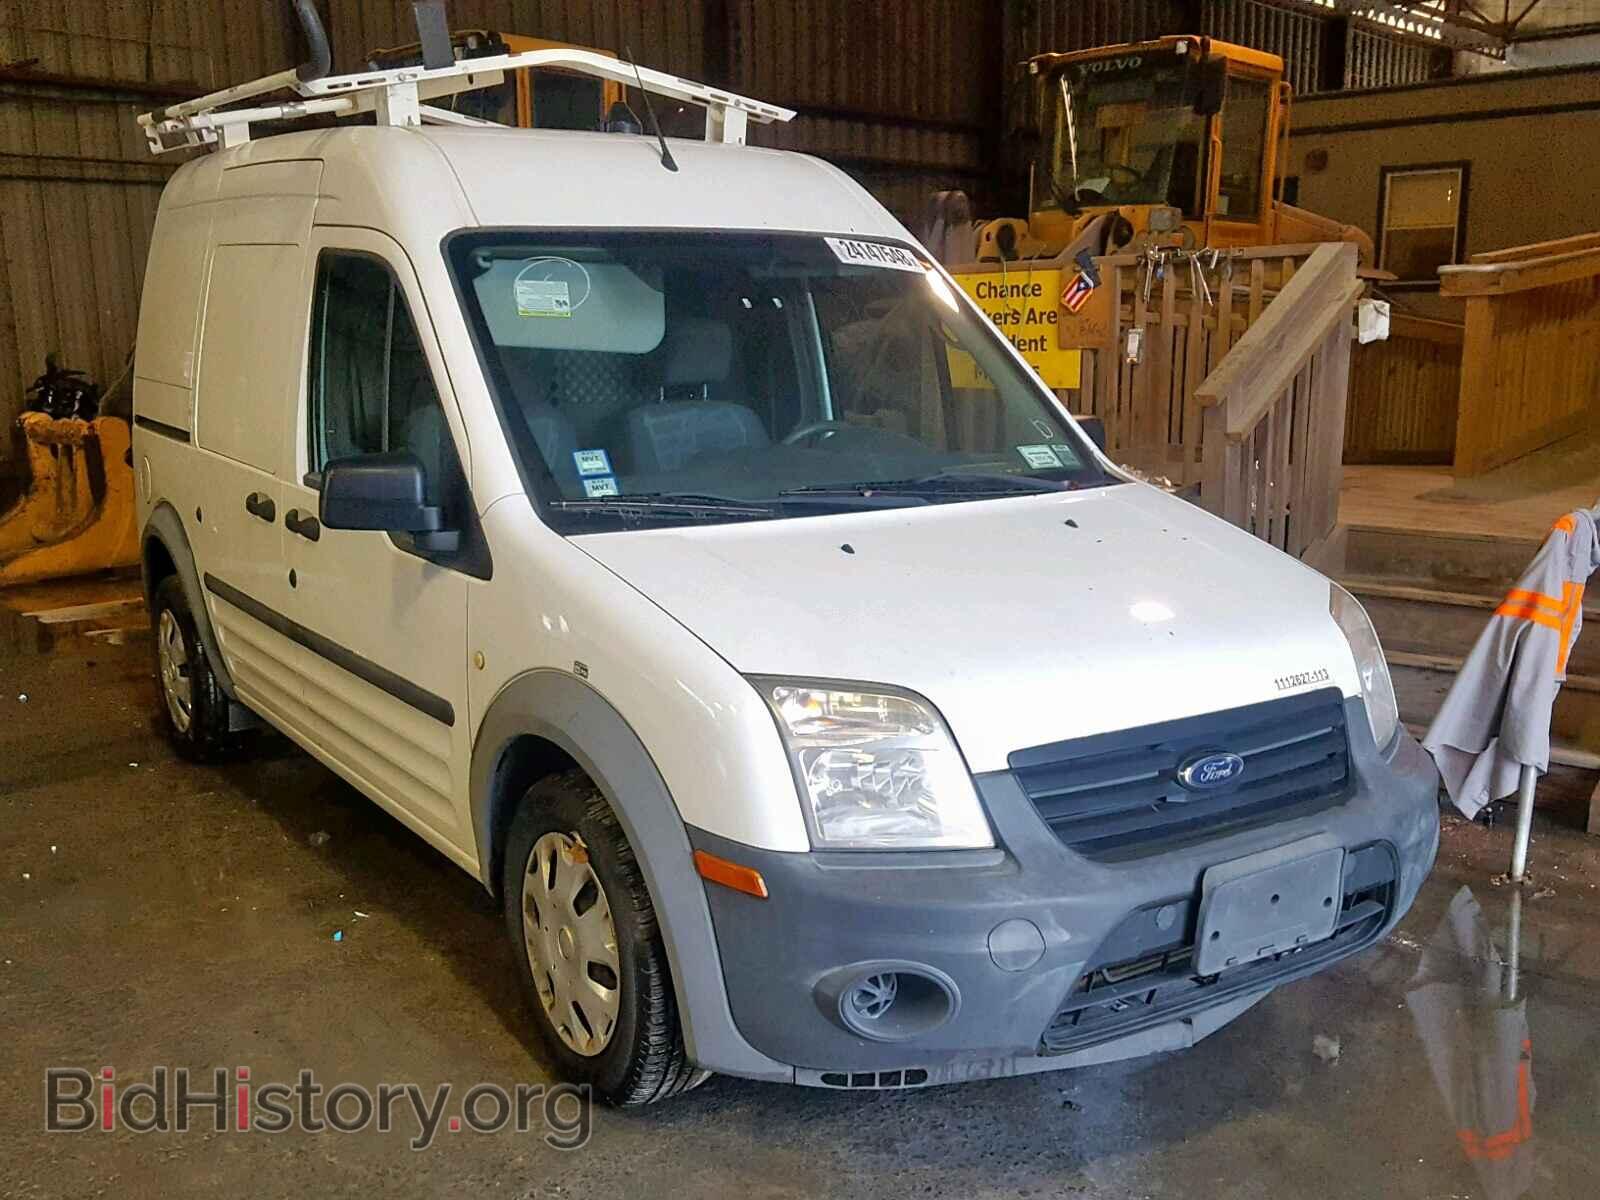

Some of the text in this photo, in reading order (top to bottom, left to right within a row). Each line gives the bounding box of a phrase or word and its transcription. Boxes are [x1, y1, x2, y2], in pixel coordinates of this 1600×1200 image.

[1077, 57, 1142, 75] VOLVO
[975, 281, 1042, 299] Chance
[1025, 308, 1057, 325] Are
[1200, 761, 1232, 782] Ford
